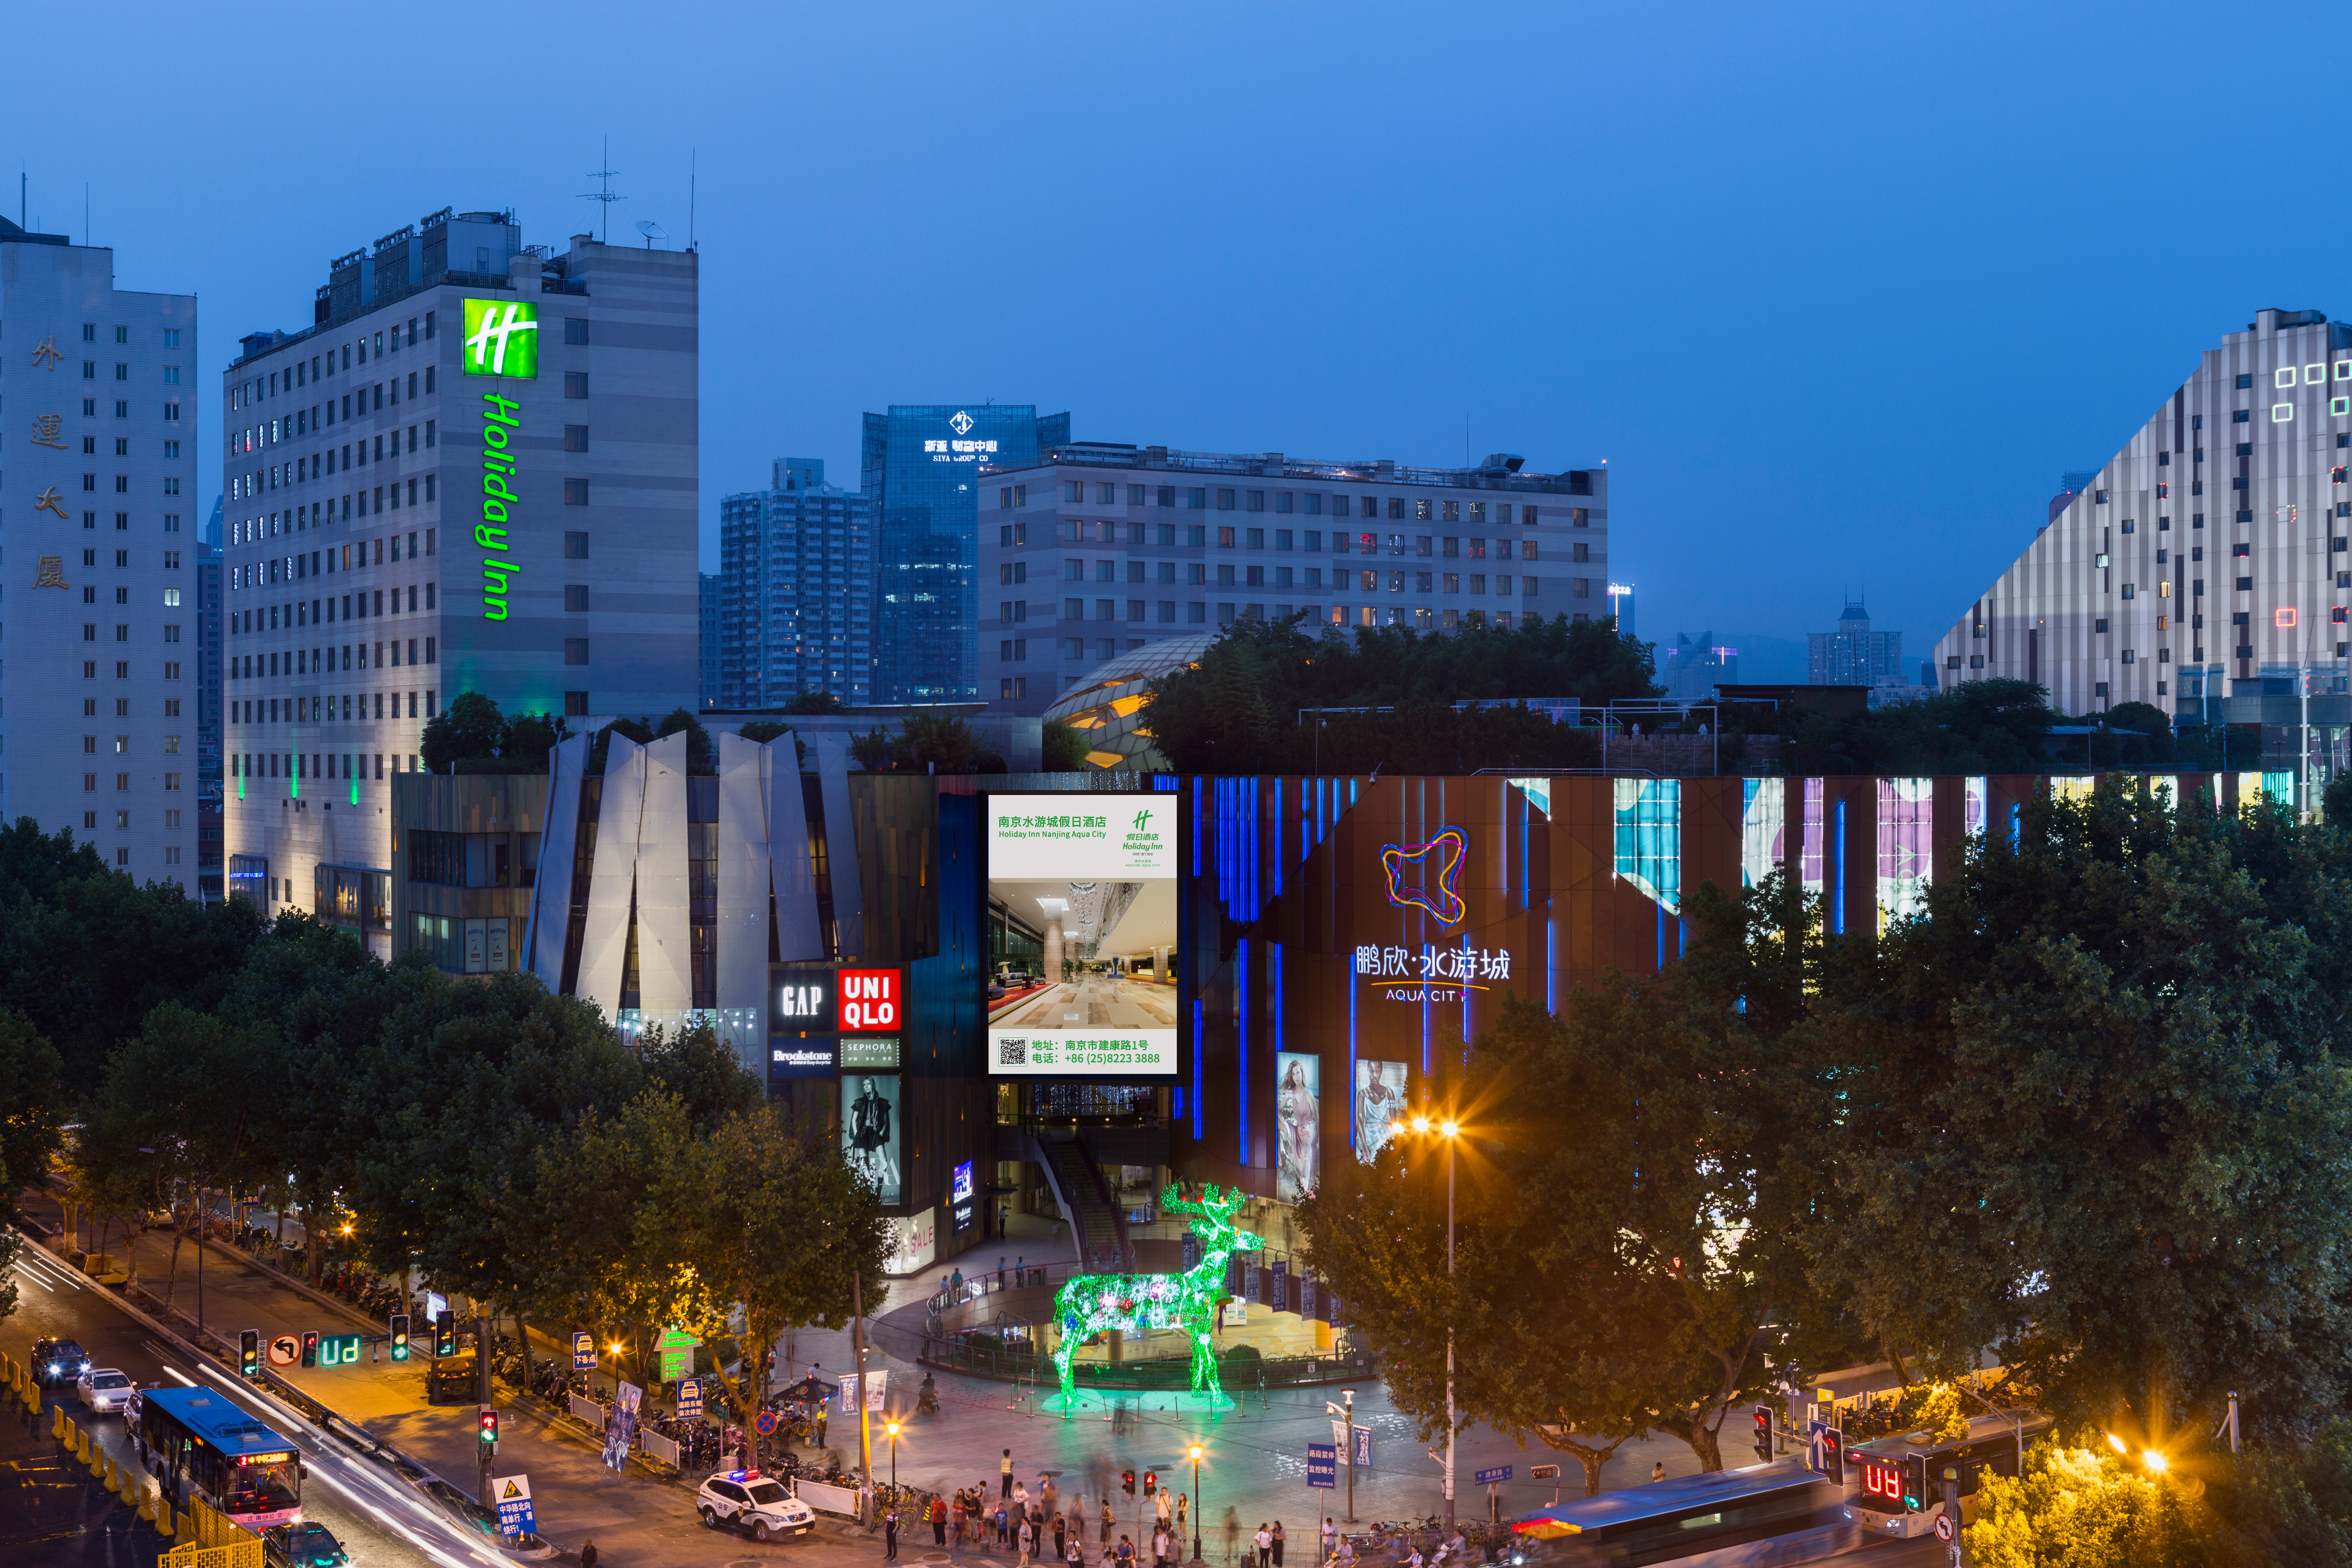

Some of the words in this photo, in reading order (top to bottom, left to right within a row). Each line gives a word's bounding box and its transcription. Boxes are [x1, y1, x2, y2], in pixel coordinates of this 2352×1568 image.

[475, 392, 520, 551] Holiday
[483, 558, 520, 621] Inn
[998, 815, 1107, 828] 南京水游城假日酒店
[999, 831, 1027, 839] Holiday
[1042, 831, 1070, 839] Nanjing
[1071, 831, 1090, 839] Aqua
[1092, 830, 1107, 839] City
[1123, 842, 1150, 851] Holiday
[1356, 944, 1510, 980] 鹏欣·水游城
[845, 977, 889, 998] UNI
[1386, 989, 1427, 1002] AQUA
[1431, 990, 1468, 1002] CITY
[783, 987, 822, 1016] GAP
[845, 1002, 893, 1028] QLO
[773, 1050, 832, 1061] Brookstone
[1087, 1053, 1132, 1065] (25)8223
[1135, 1054, 1160, 1063] 3888
[911, 1225, 933, 1254] SALE
[662, 1339, 686, 1348] Holiday
[575, 1354, 596, 1364] 下客点
[679, 1400, 702, 1408] 道路东侧
[679, 1408, 702, 1417] 依次停放
[1309, 1450, 1334, 1459] 路段禁停
[241, 1456, 247, 1465] 2
[1309, 1465, 1334, 1475] 监控曝光
[1485, 1469, 1503, 1478] 建康路
[499, 1501, 531, 1514] 中华路北向
[718, 1502, 728, 1511] 公安
